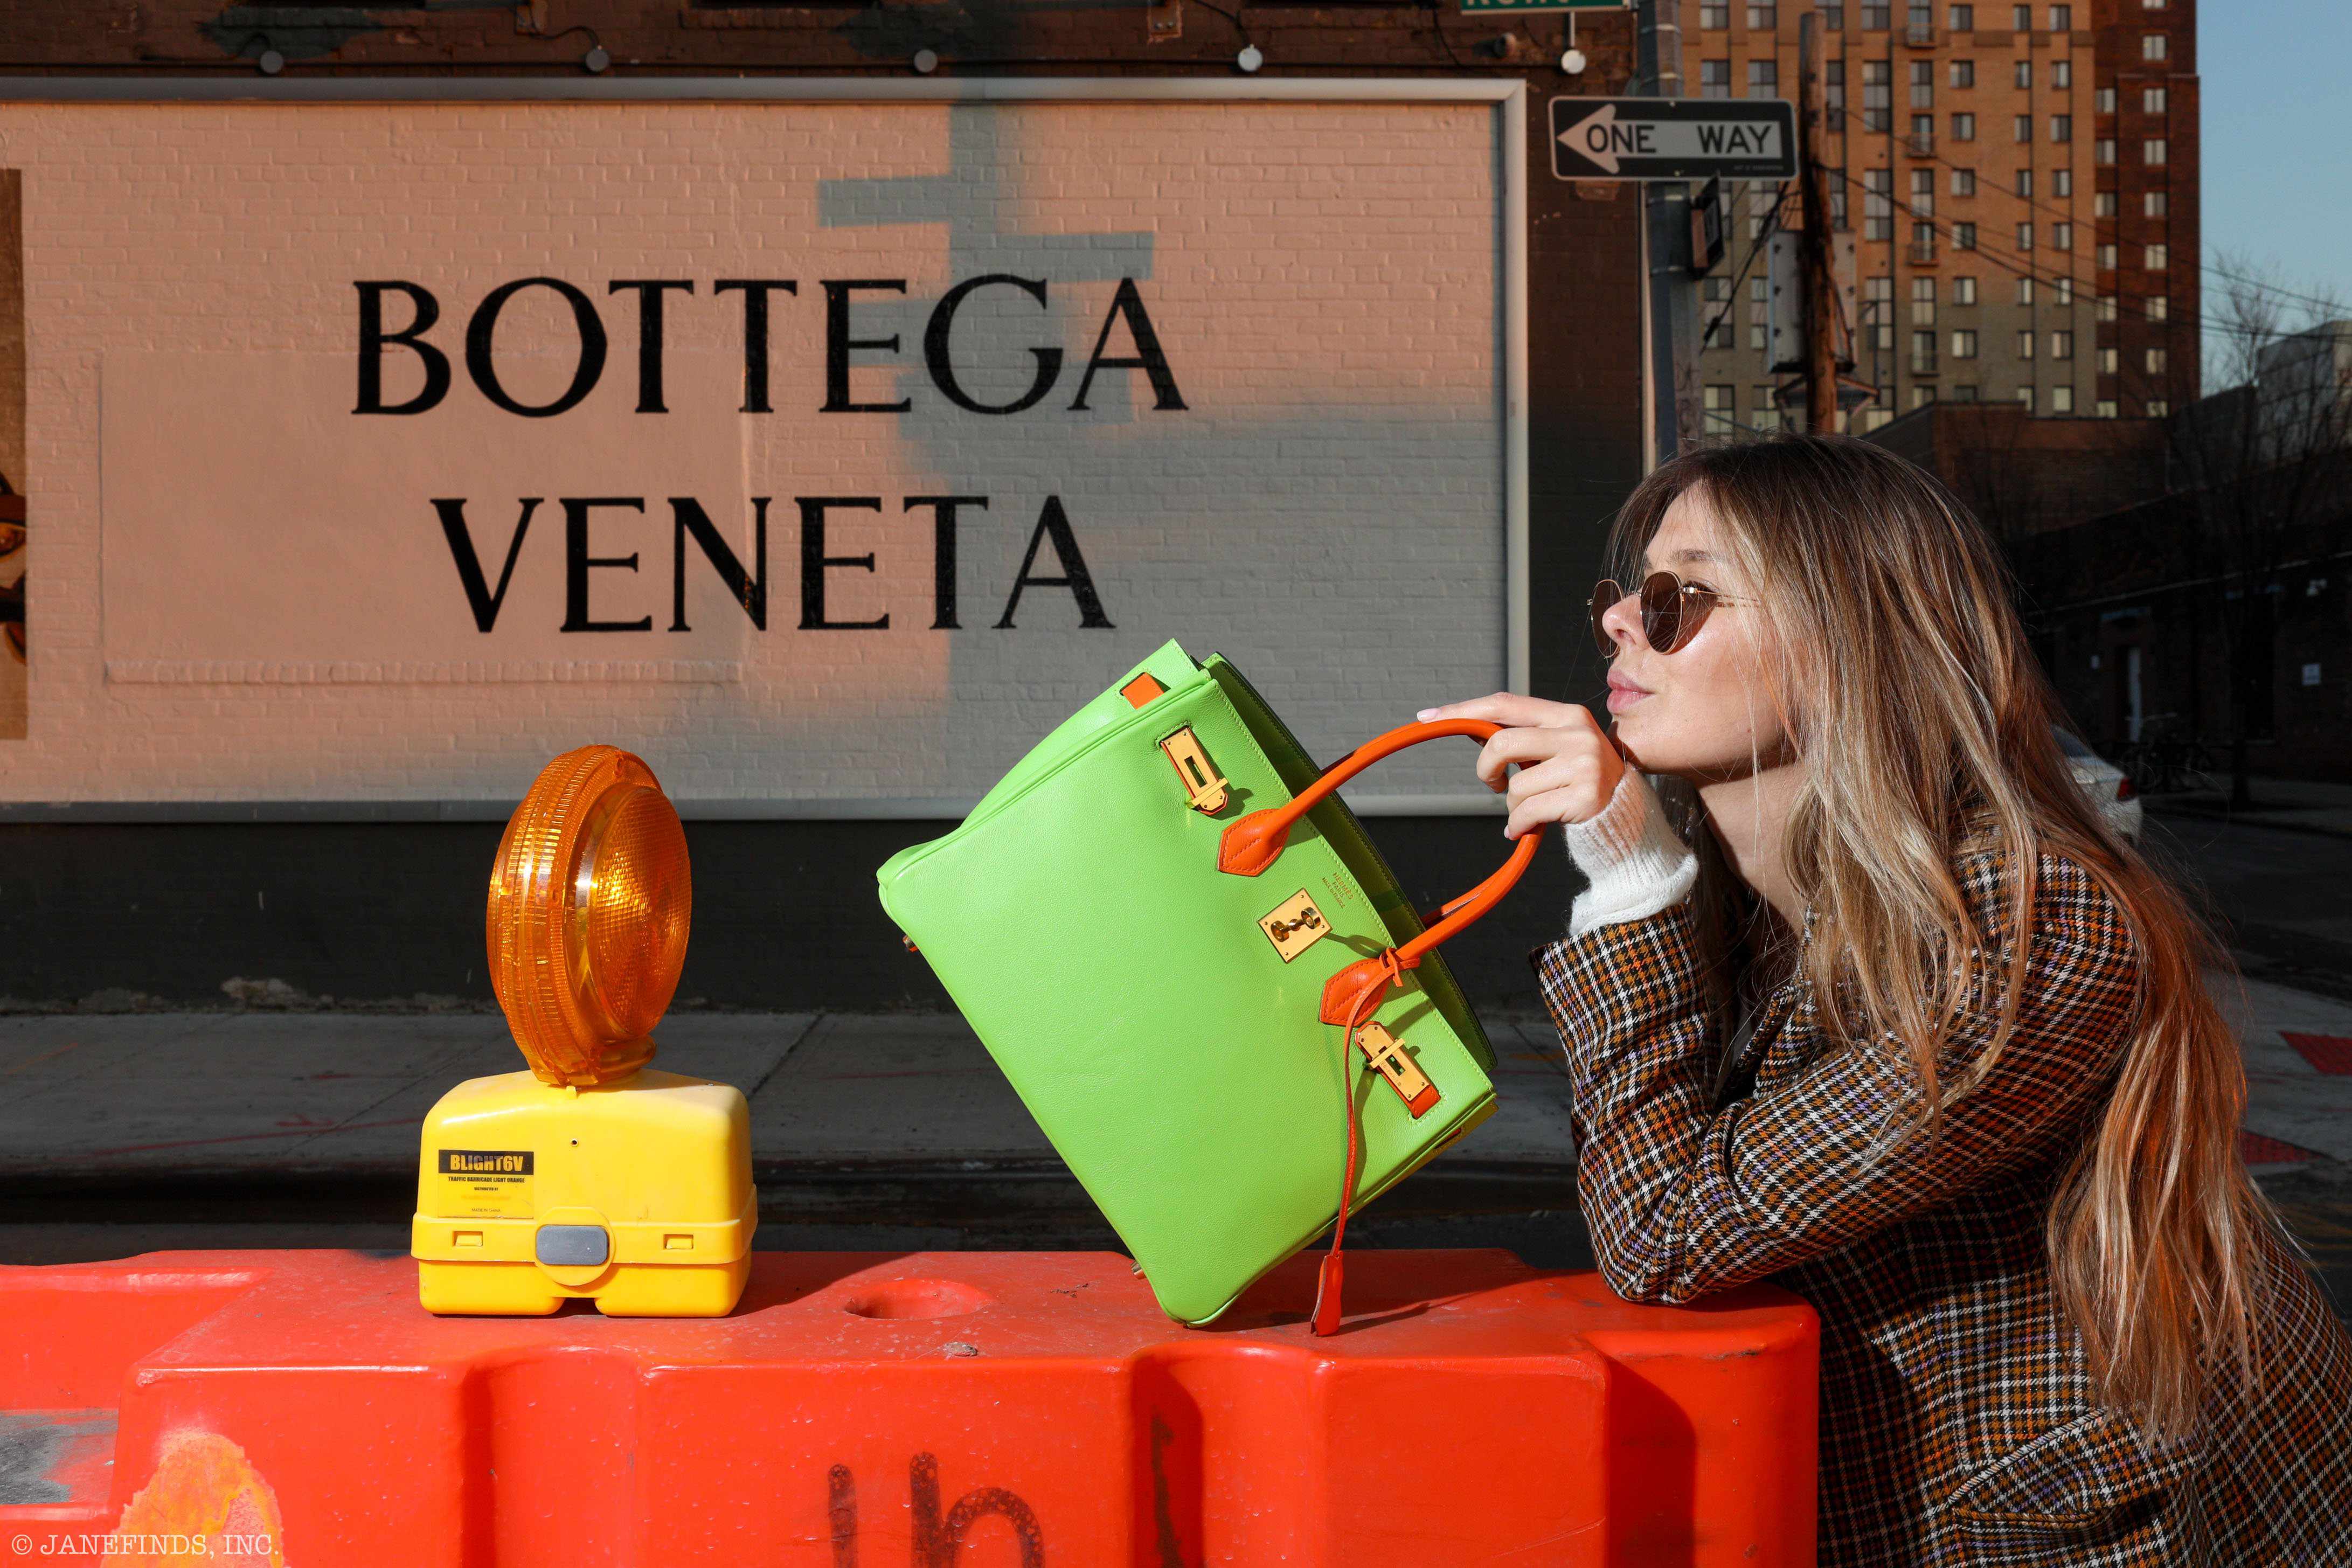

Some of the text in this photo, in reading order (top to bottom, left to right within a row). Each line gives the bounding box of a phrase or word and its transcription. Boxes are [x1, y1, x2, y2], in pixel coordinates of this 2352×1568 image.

[1586, 123, 1772, 154] ONE WAY
[351, 274, 1189, 418] BOTTEGA
[430, 495, 1116, 633] VENETA
[450, 1154, 524, 1172] BLIGHT6V
